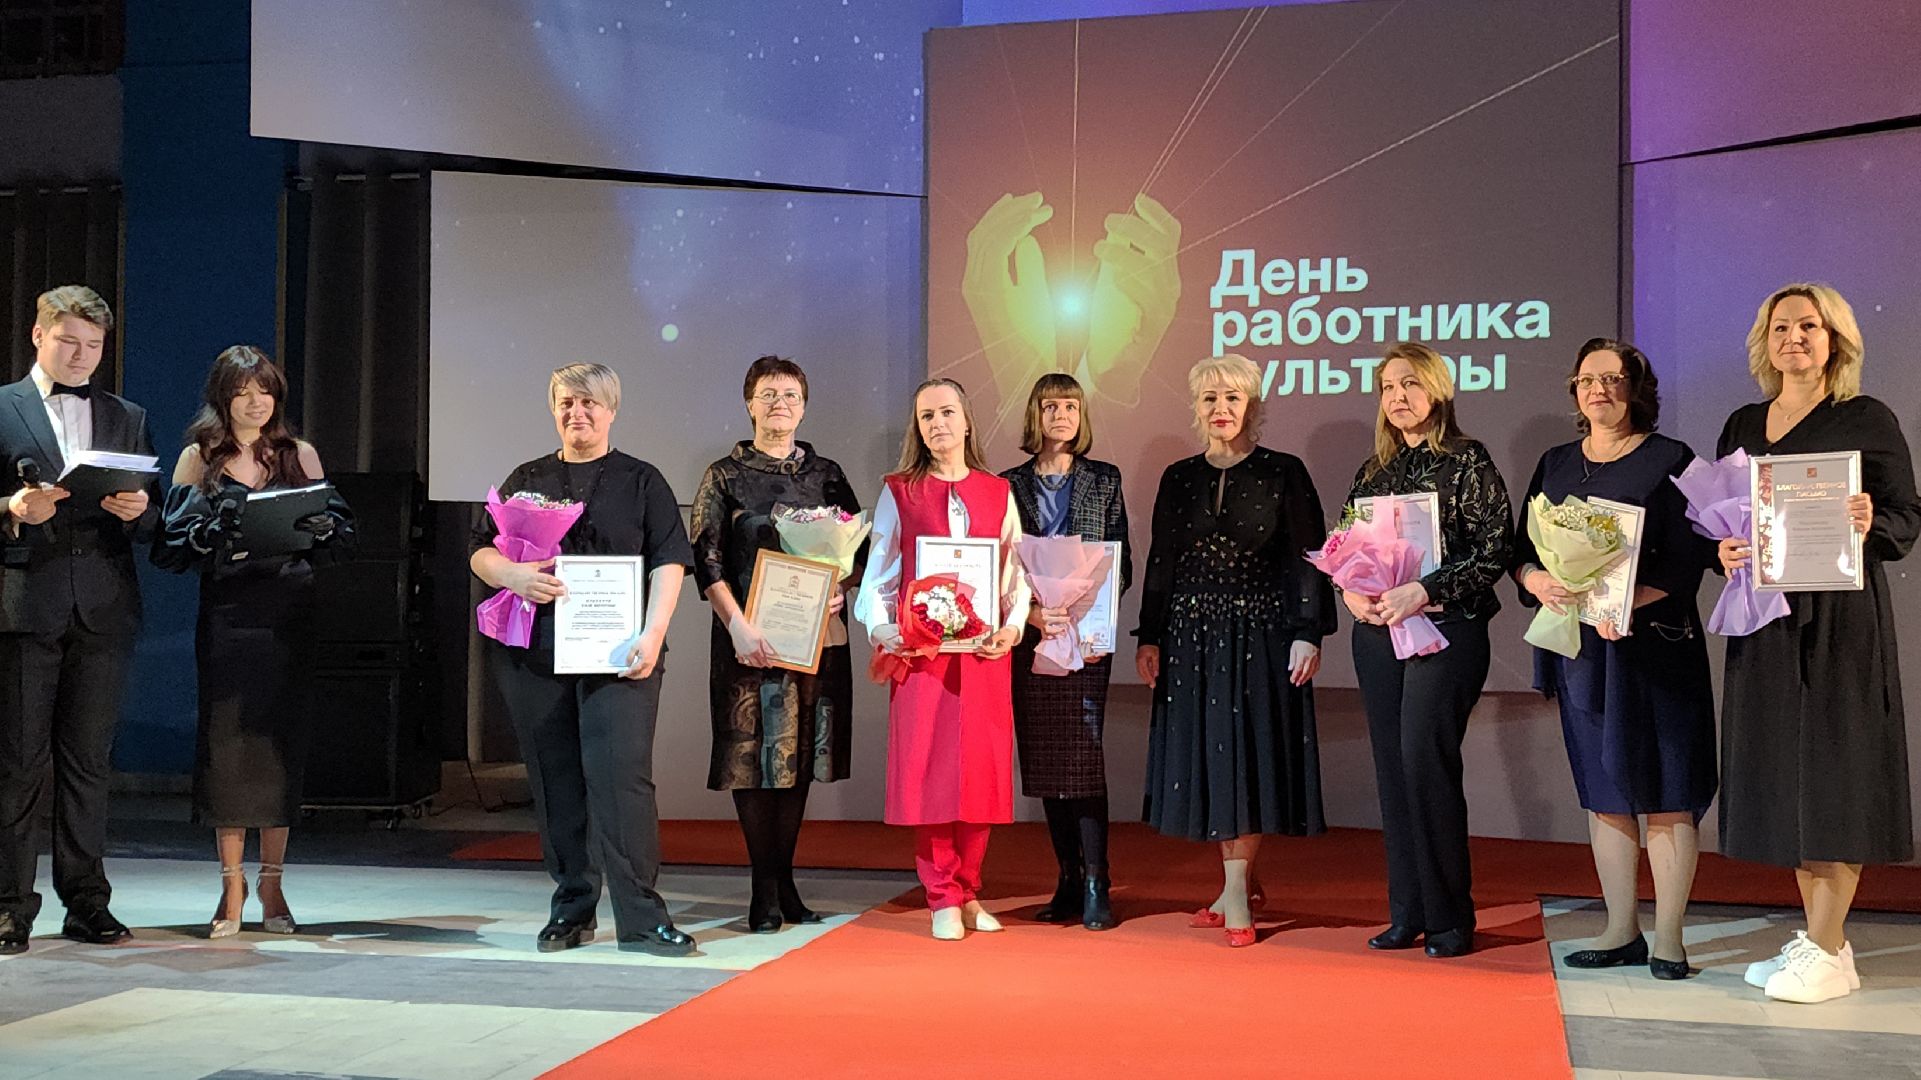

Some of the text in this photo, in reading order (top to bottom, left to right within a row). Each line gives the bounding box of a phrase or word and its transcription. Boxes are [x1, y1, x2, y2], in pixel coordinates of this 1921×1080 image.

[1209, 248, 1369, 308] День
[1212, 294, 1551, 357] работника
[1260, 353, 1507, 402] ульты
[1776, 481, 1847, 491] БЛАГОДСТВЕННОЕ
